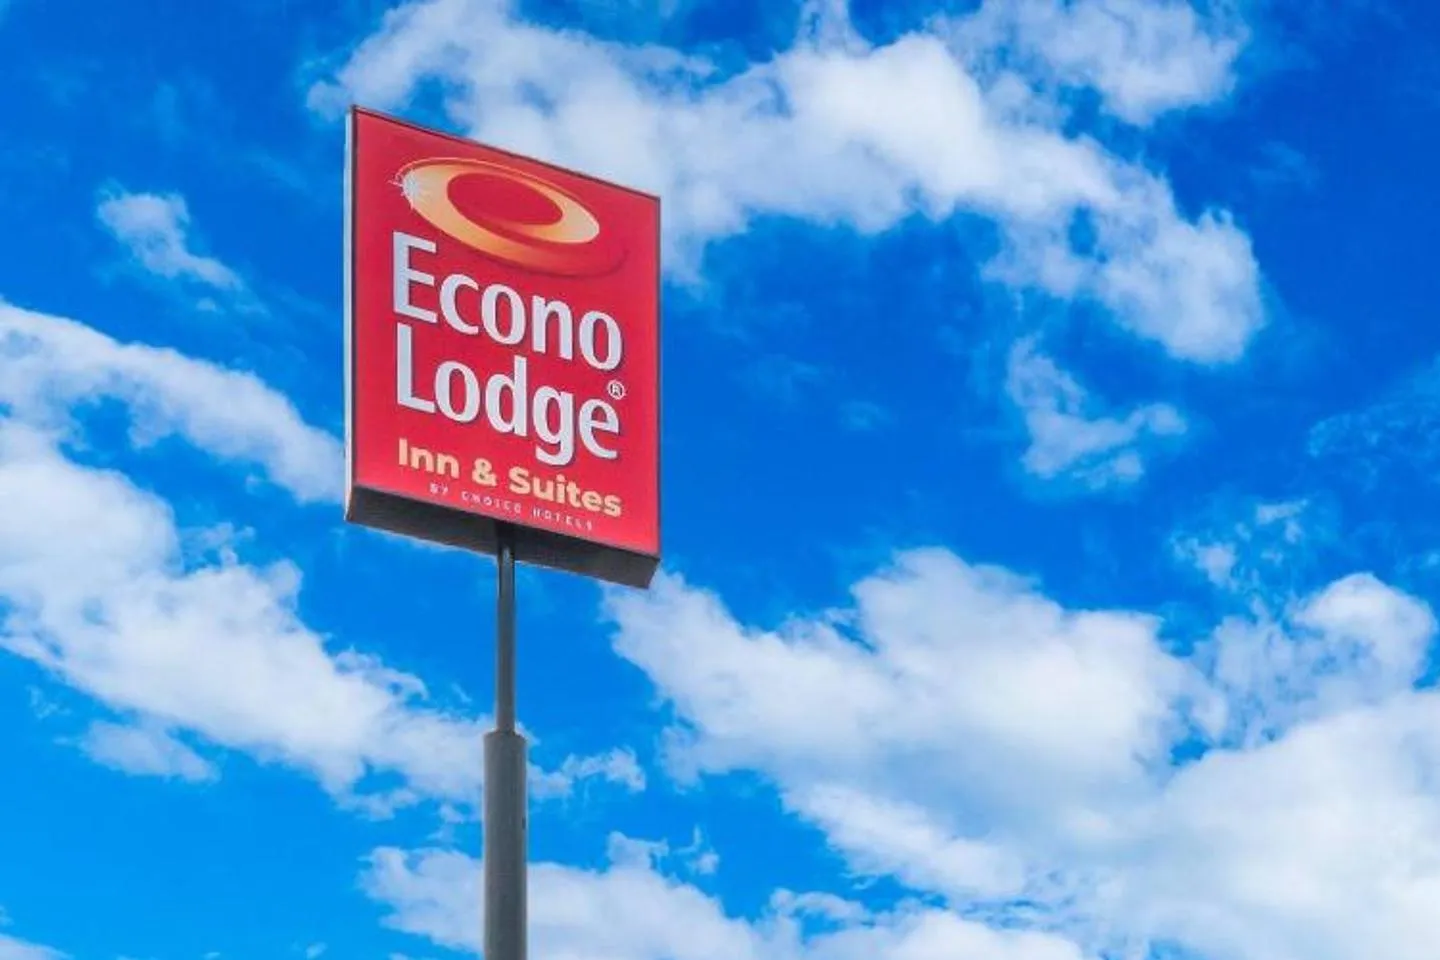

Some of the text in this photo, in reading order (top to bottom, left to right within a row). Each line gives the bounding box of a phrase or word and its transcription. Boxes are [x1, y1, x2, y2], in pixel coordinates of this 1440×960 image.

[393, 231, 622, 371] Econo
[398, 438, 622, 517] Inn & Suites
